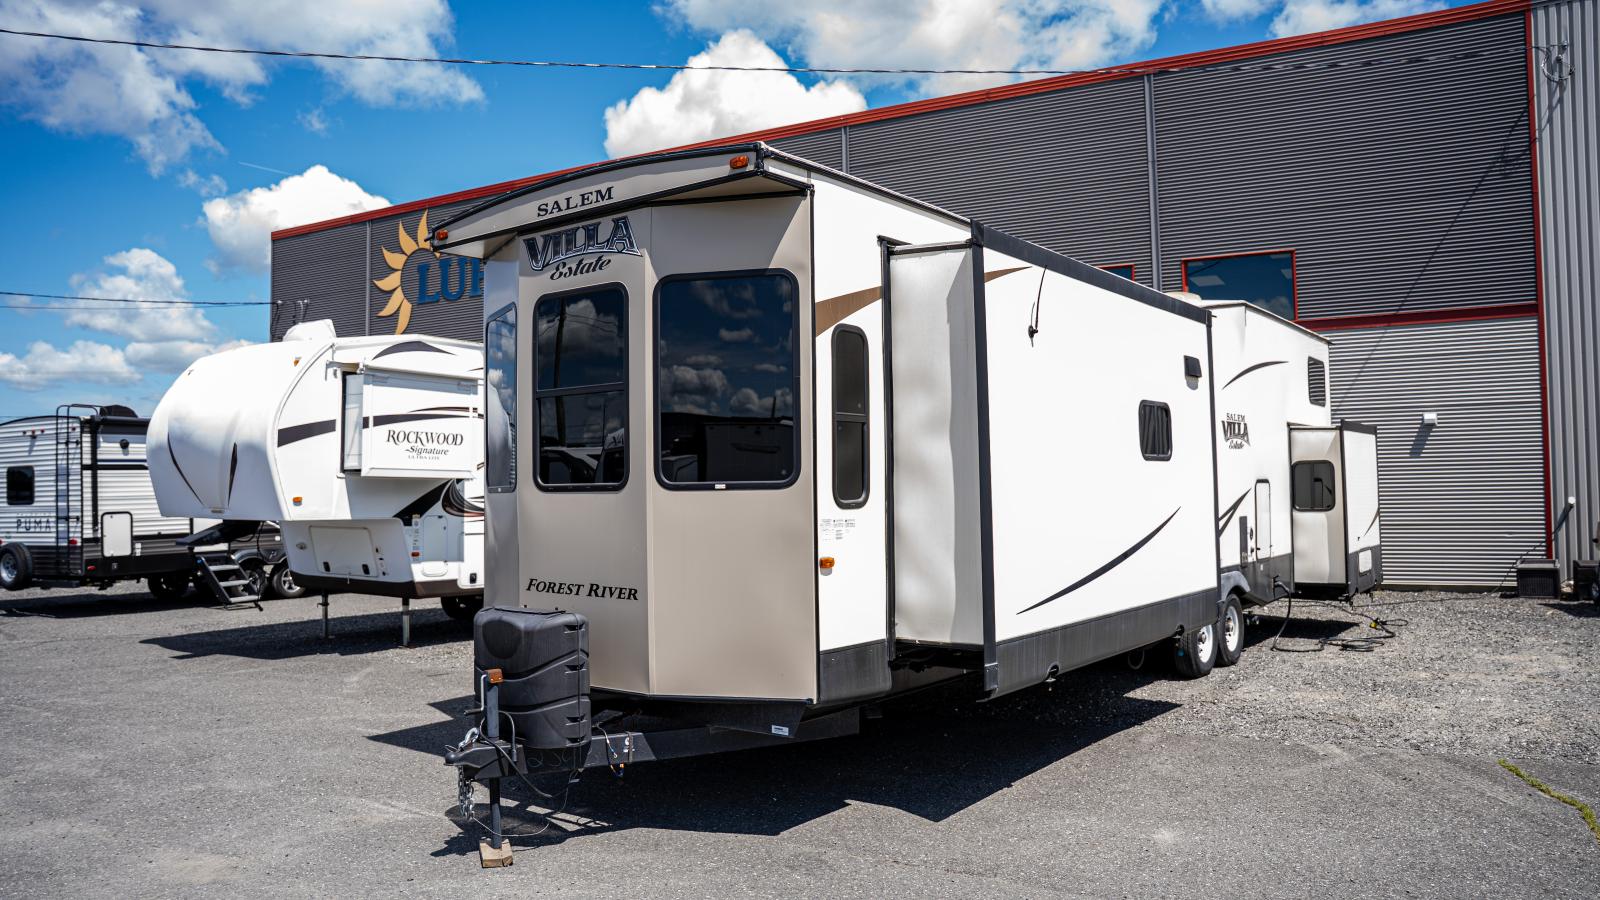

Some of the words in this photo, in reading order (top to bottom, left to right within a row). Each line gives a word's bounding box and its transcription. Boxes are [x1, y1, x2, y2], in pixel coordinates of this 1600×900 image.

[537, 186, 614, 216] SALEM
[522, 216, 643, 271] VILLA
[549, 254, 612, 280] Estate
[1226, 412, 1246, 422] SALEM
[386, 429, 463, 446] ROCKWOOD
[1221, 420, 1251, 447] VILLA
[404, 445, 449, 455] Signature
[16, 519, 51, 532] PUMA
[526, 578, 585, 596] FOREST
[586, 583, 639, 601] RIVER
